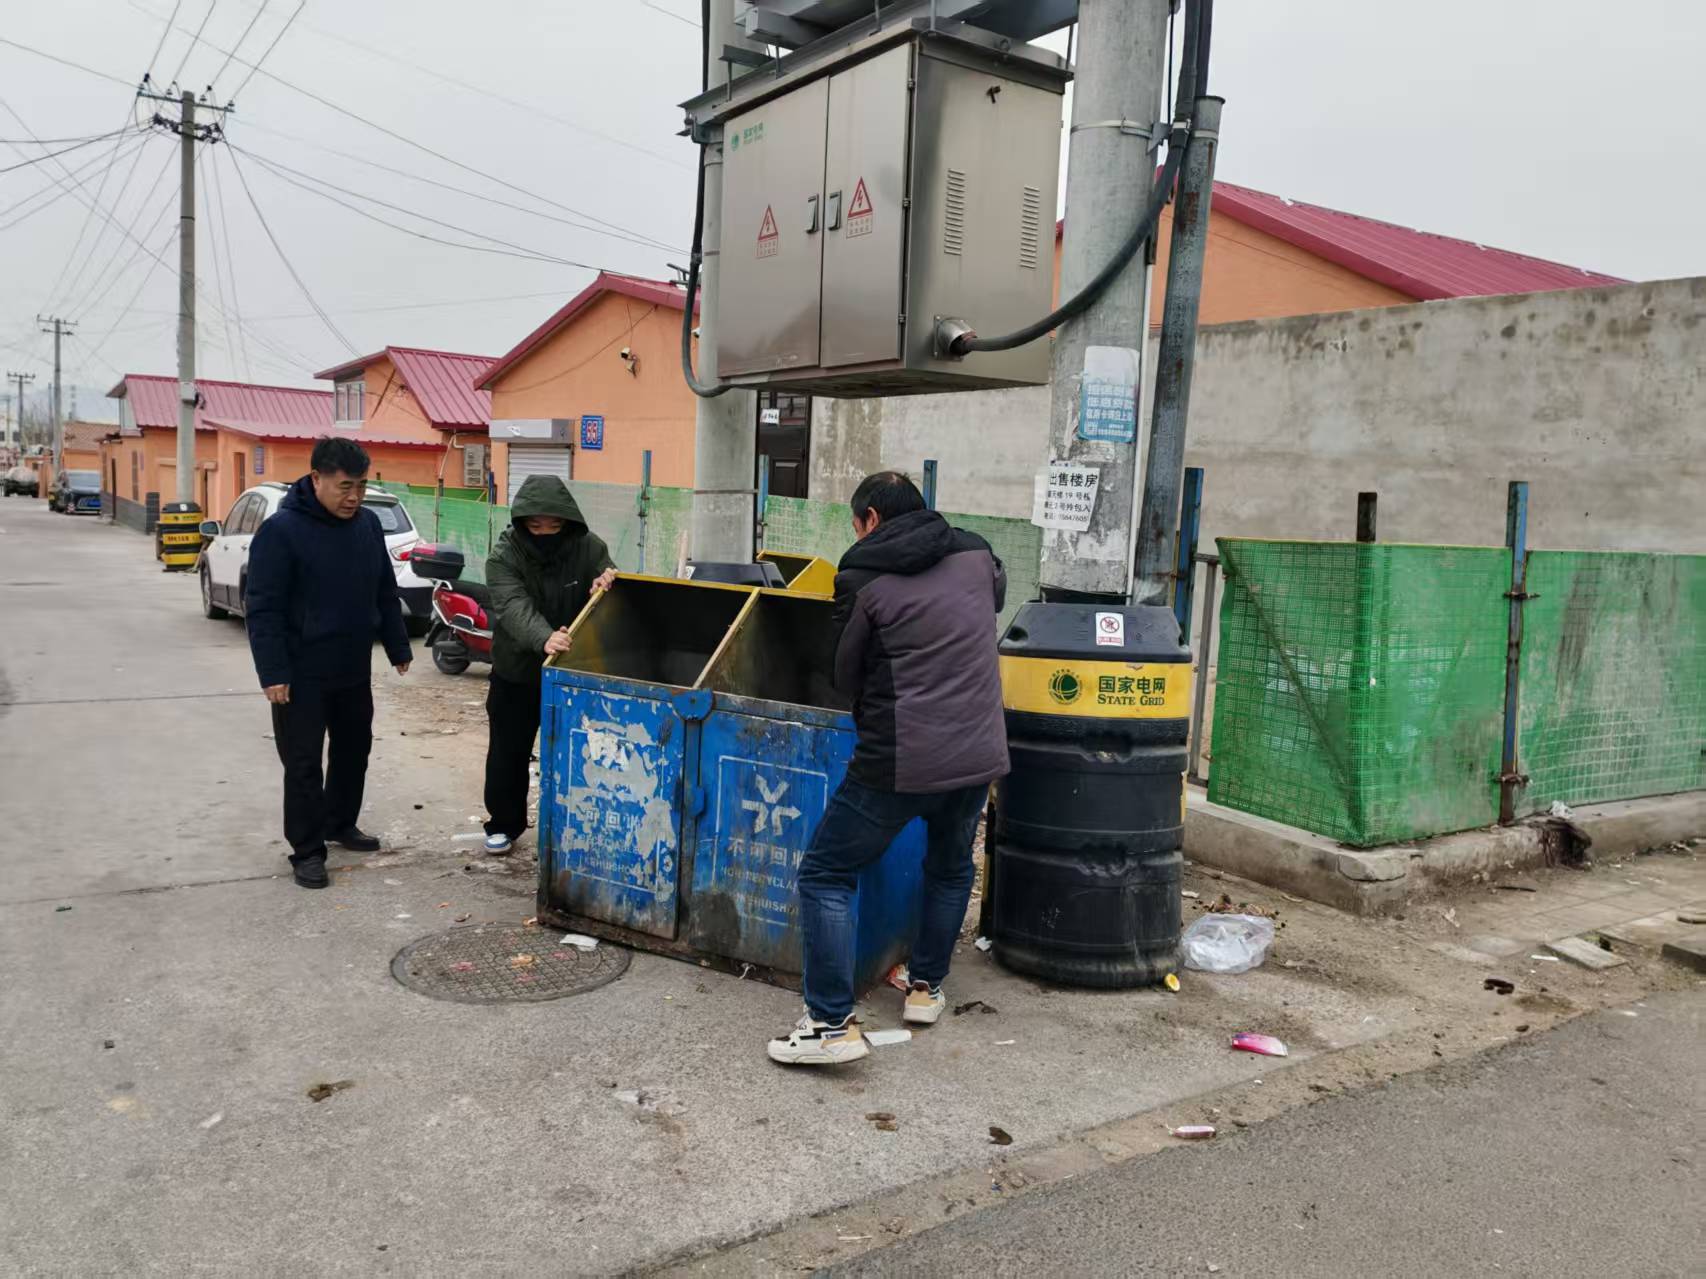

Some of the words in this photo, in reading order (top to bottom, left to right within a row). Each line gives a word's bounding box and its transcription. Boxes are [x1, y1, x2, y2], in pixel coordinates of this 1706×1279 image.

[1050, 471, 1098, 487] 出售楼房
[1098, 676, 1166, 695] 国家电网
[1097, 693, 1135, 706] STATE
[1139, 694, 1165, 706] GRID
